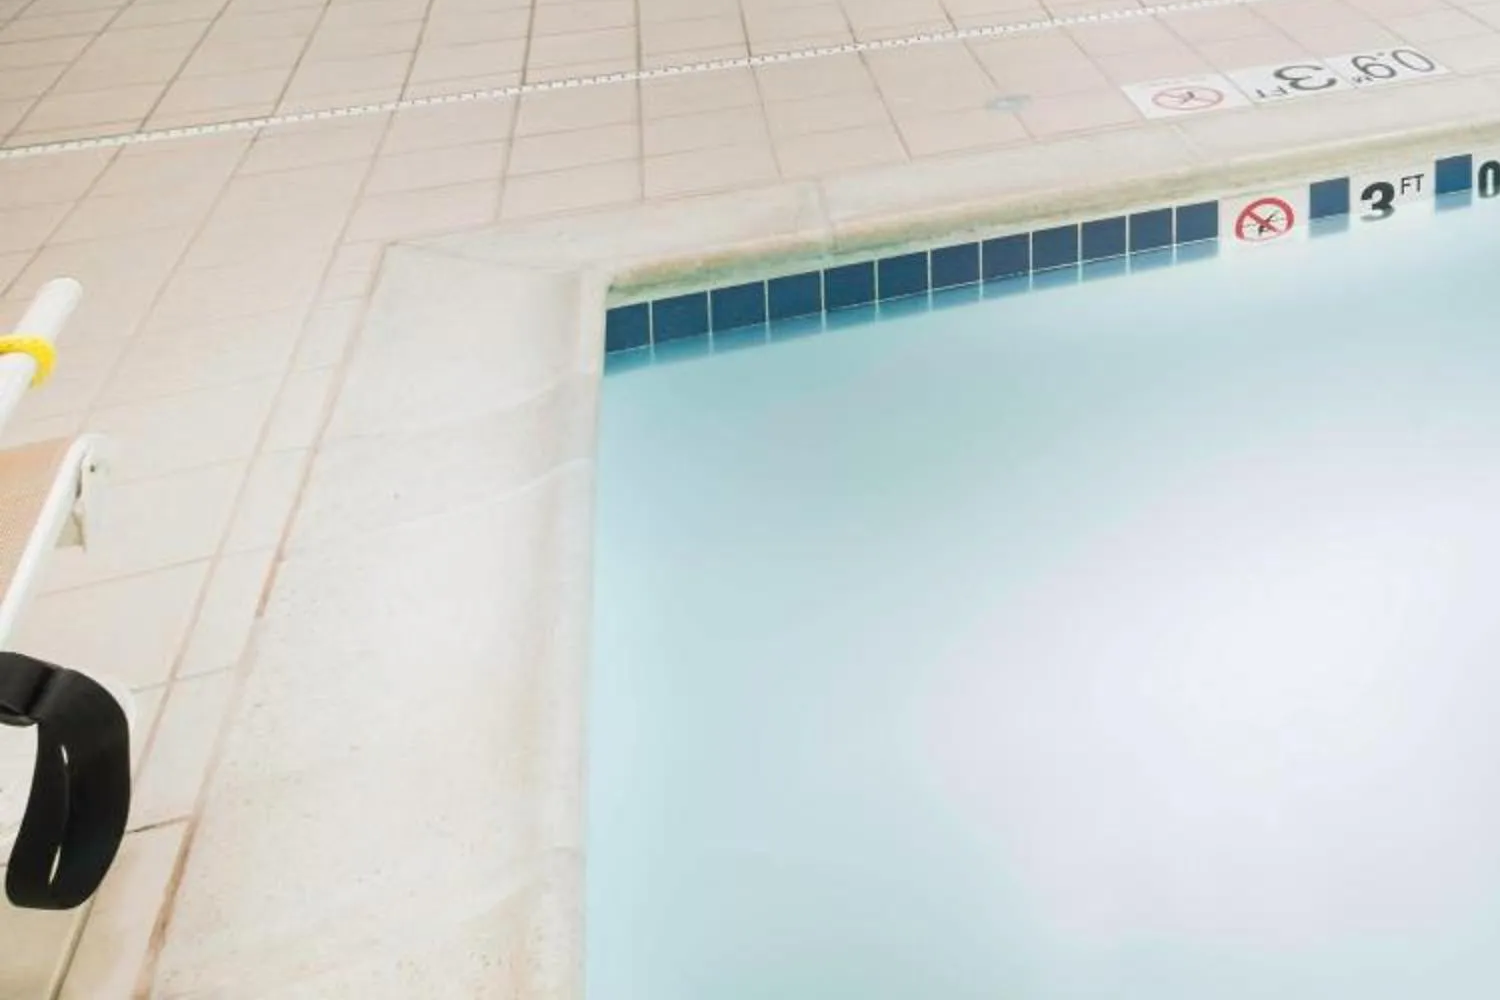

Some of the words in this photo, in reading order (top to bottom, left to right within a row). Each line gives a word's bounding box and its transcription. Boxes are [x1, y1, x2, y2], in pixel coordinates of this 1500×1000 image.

[1273, 64, 1337, 91] 3
[1360, 182, 1395, 222] 3
[1401, 173, 1425, 195] FT
